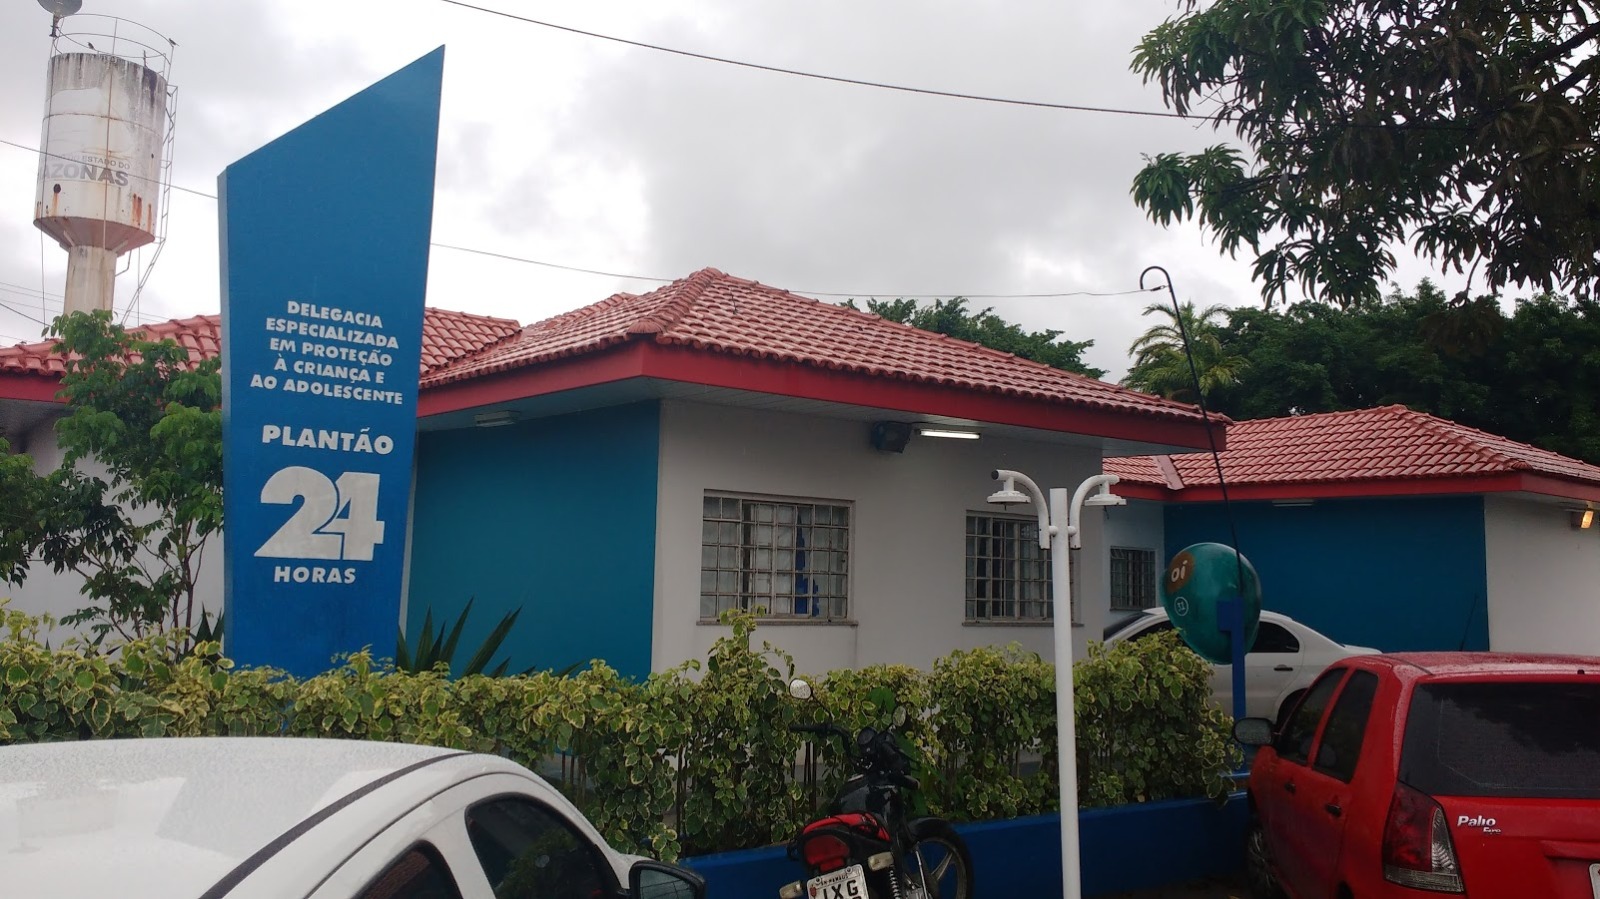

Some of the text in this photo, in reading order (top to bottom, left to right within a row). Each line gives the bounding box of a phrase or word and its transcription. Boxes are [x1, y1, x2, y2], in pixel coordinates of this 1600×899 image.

[82, 155, 116, 167] ESTADO
[118, 161, 130, 170] DO
[287, 300, 383, 329] DELEGACIA
[266, 317, 399, 349] ESPECIALIZADA
[270, 337, 393, 367] EM PROTEÇÃO
[274, 353, 385, 384] À CRIANÇA E
[250, 374, 403, 405] AO ADOLESCENTE
[262, 424, 394, 455] PLANTÃO
[253, 465, 385, 561] 24
[273, 565, 356, 584] HORAS
[1171, 560, 1188, 582] oi
[1457, 815, 1496, 827] Palio
